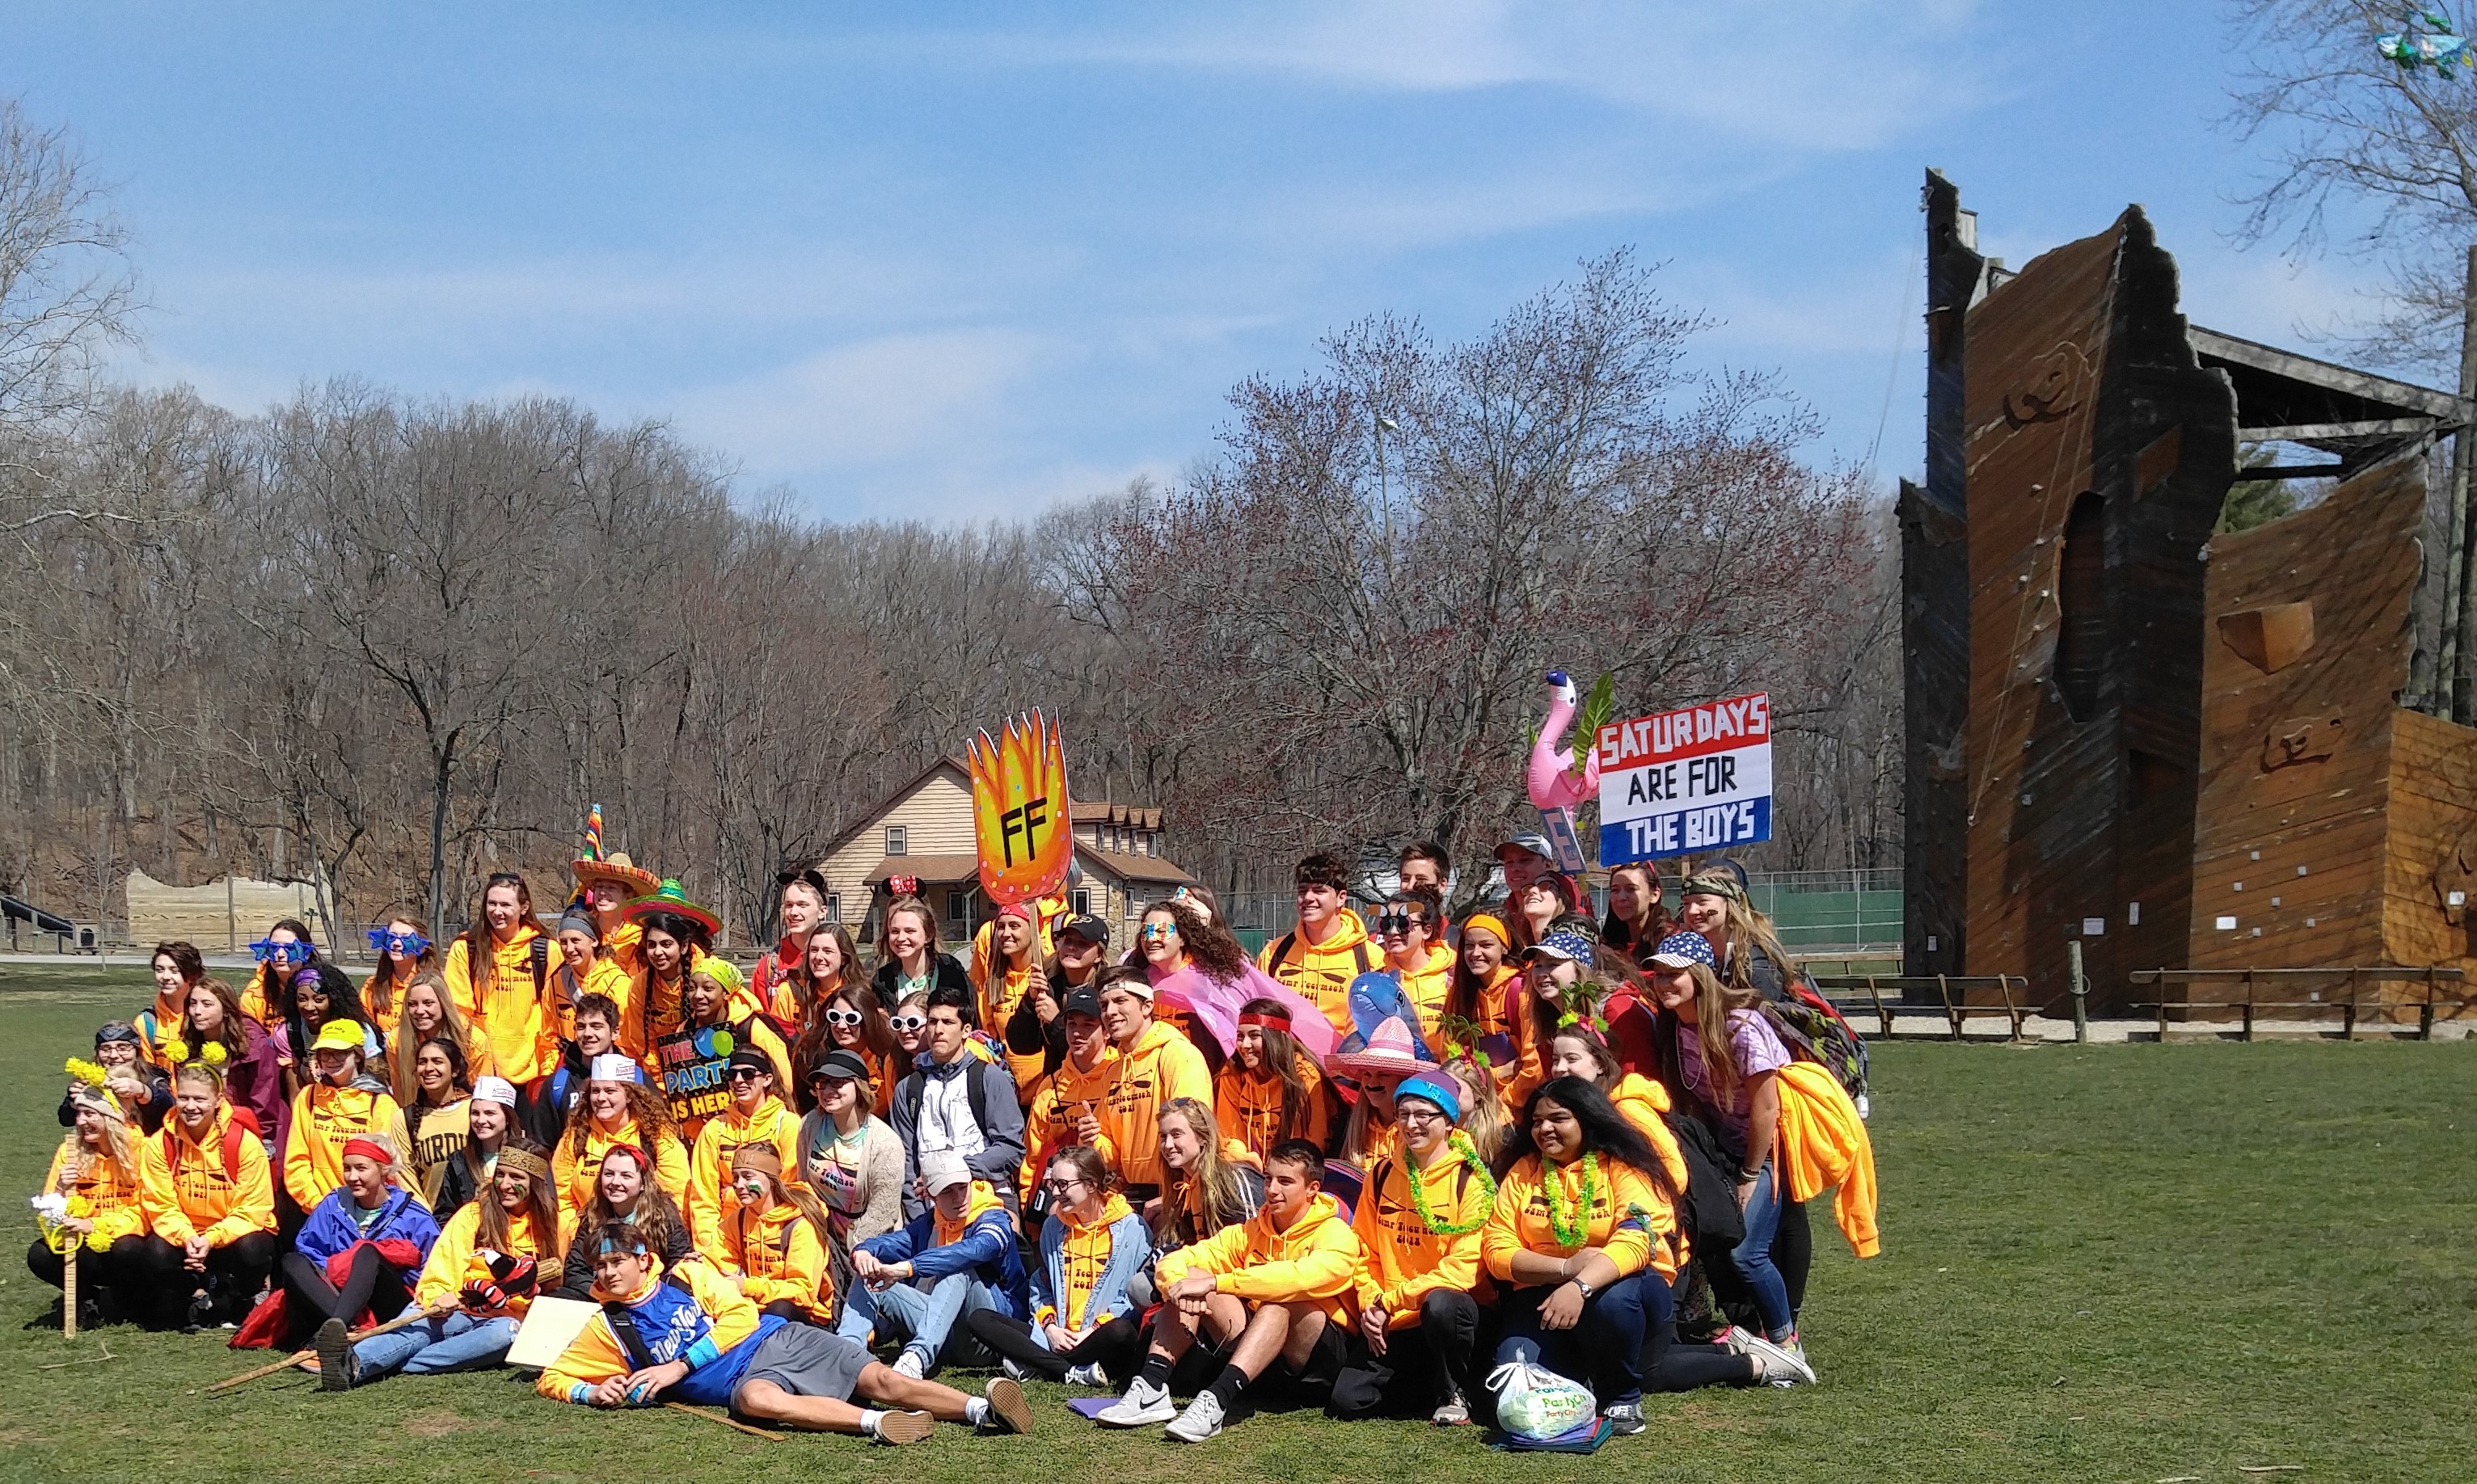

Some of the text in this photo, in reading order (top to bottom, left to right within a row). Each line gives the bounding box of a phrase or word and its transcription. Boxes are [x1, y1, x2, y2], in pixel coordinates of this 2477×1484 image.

[1601, 695, 1766, 767] SATURDAYS
[1627, 755, 1738, 806] ARE FOR
[1000, 796, 1048, 869] FF
[1543, 812, 1583, 871] E
[1625, 799, 1755, 855] THE BOYS
[659, 1039, 695, 1065] THE
[670, 1100, 689, 1120] IS
